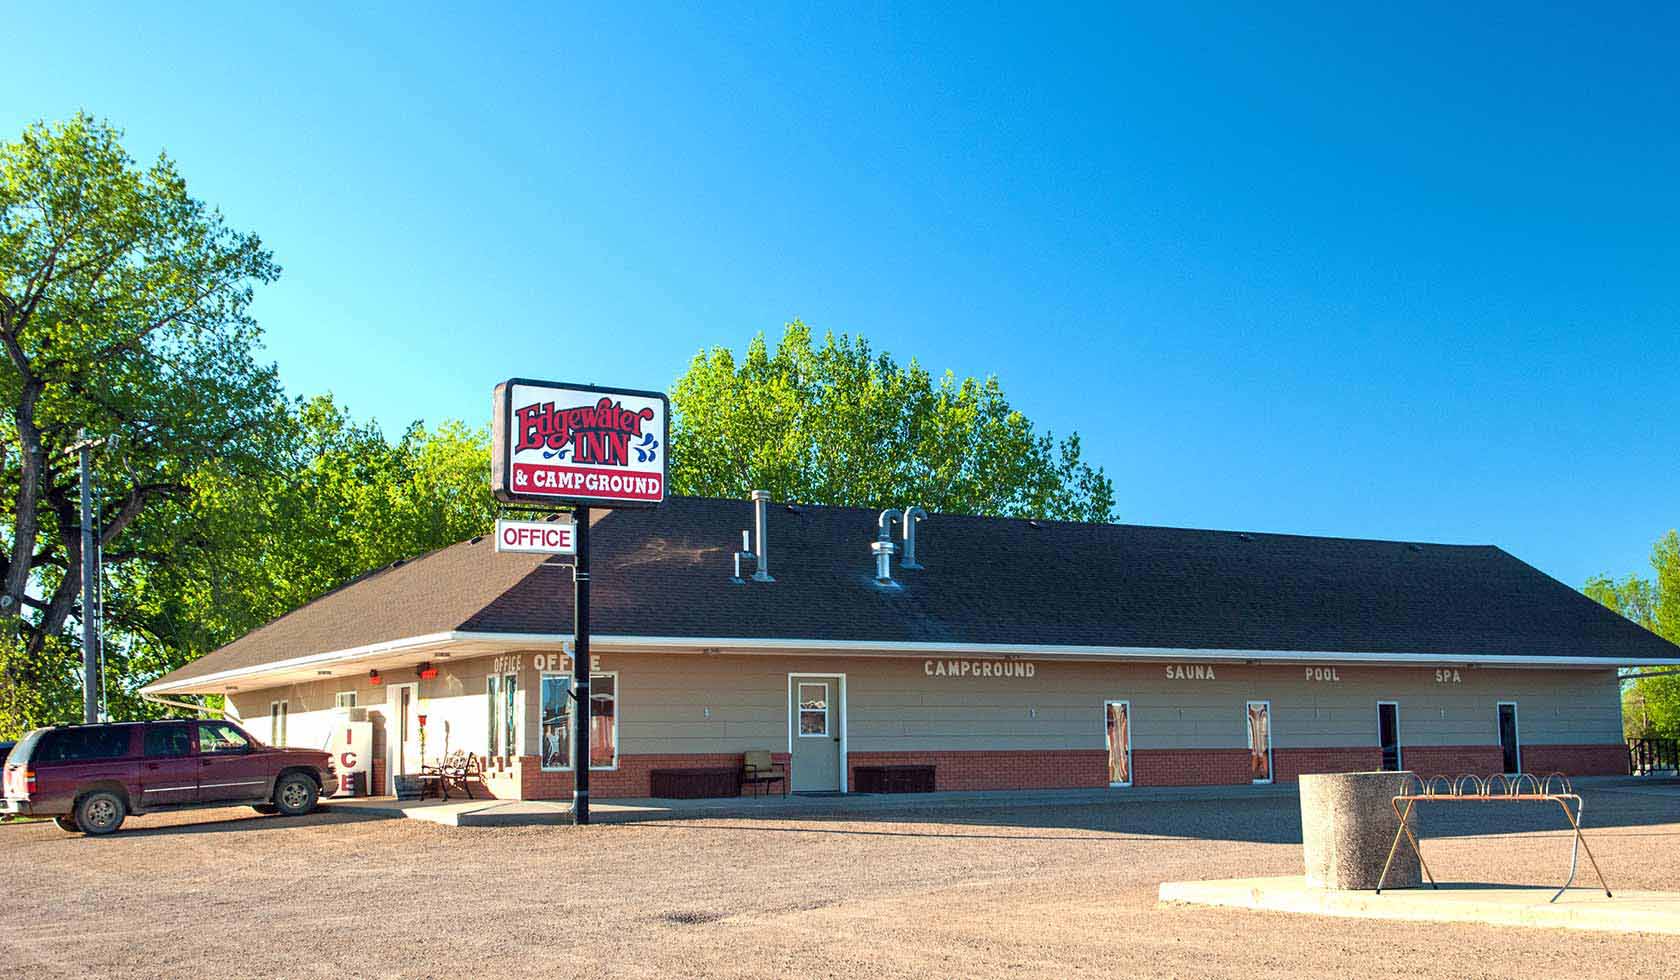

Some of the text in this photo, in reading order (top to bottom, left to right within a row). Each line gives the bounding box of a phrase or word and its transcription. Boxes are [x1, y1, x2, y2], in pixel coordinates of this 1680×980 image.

[515, 397, 654, 455] Edgewater
[572, 431, 631, 466] INN
[515, 469, 660, 494] & CAMPGROUND
[503, 528, 571, 547] OFFICE
[494, 656, 521, 672] OFFICE
[534, 654, 600, 671] OFFIE
[924, 660, 1035, 678] CAMPGROUND
[1165, 665, 1216, 680] SAUNA
[1305, 667, 1340, 681] POOL
[1435, 669, 1462, 683] SPA
[340, 728, 357, 792] ICE
